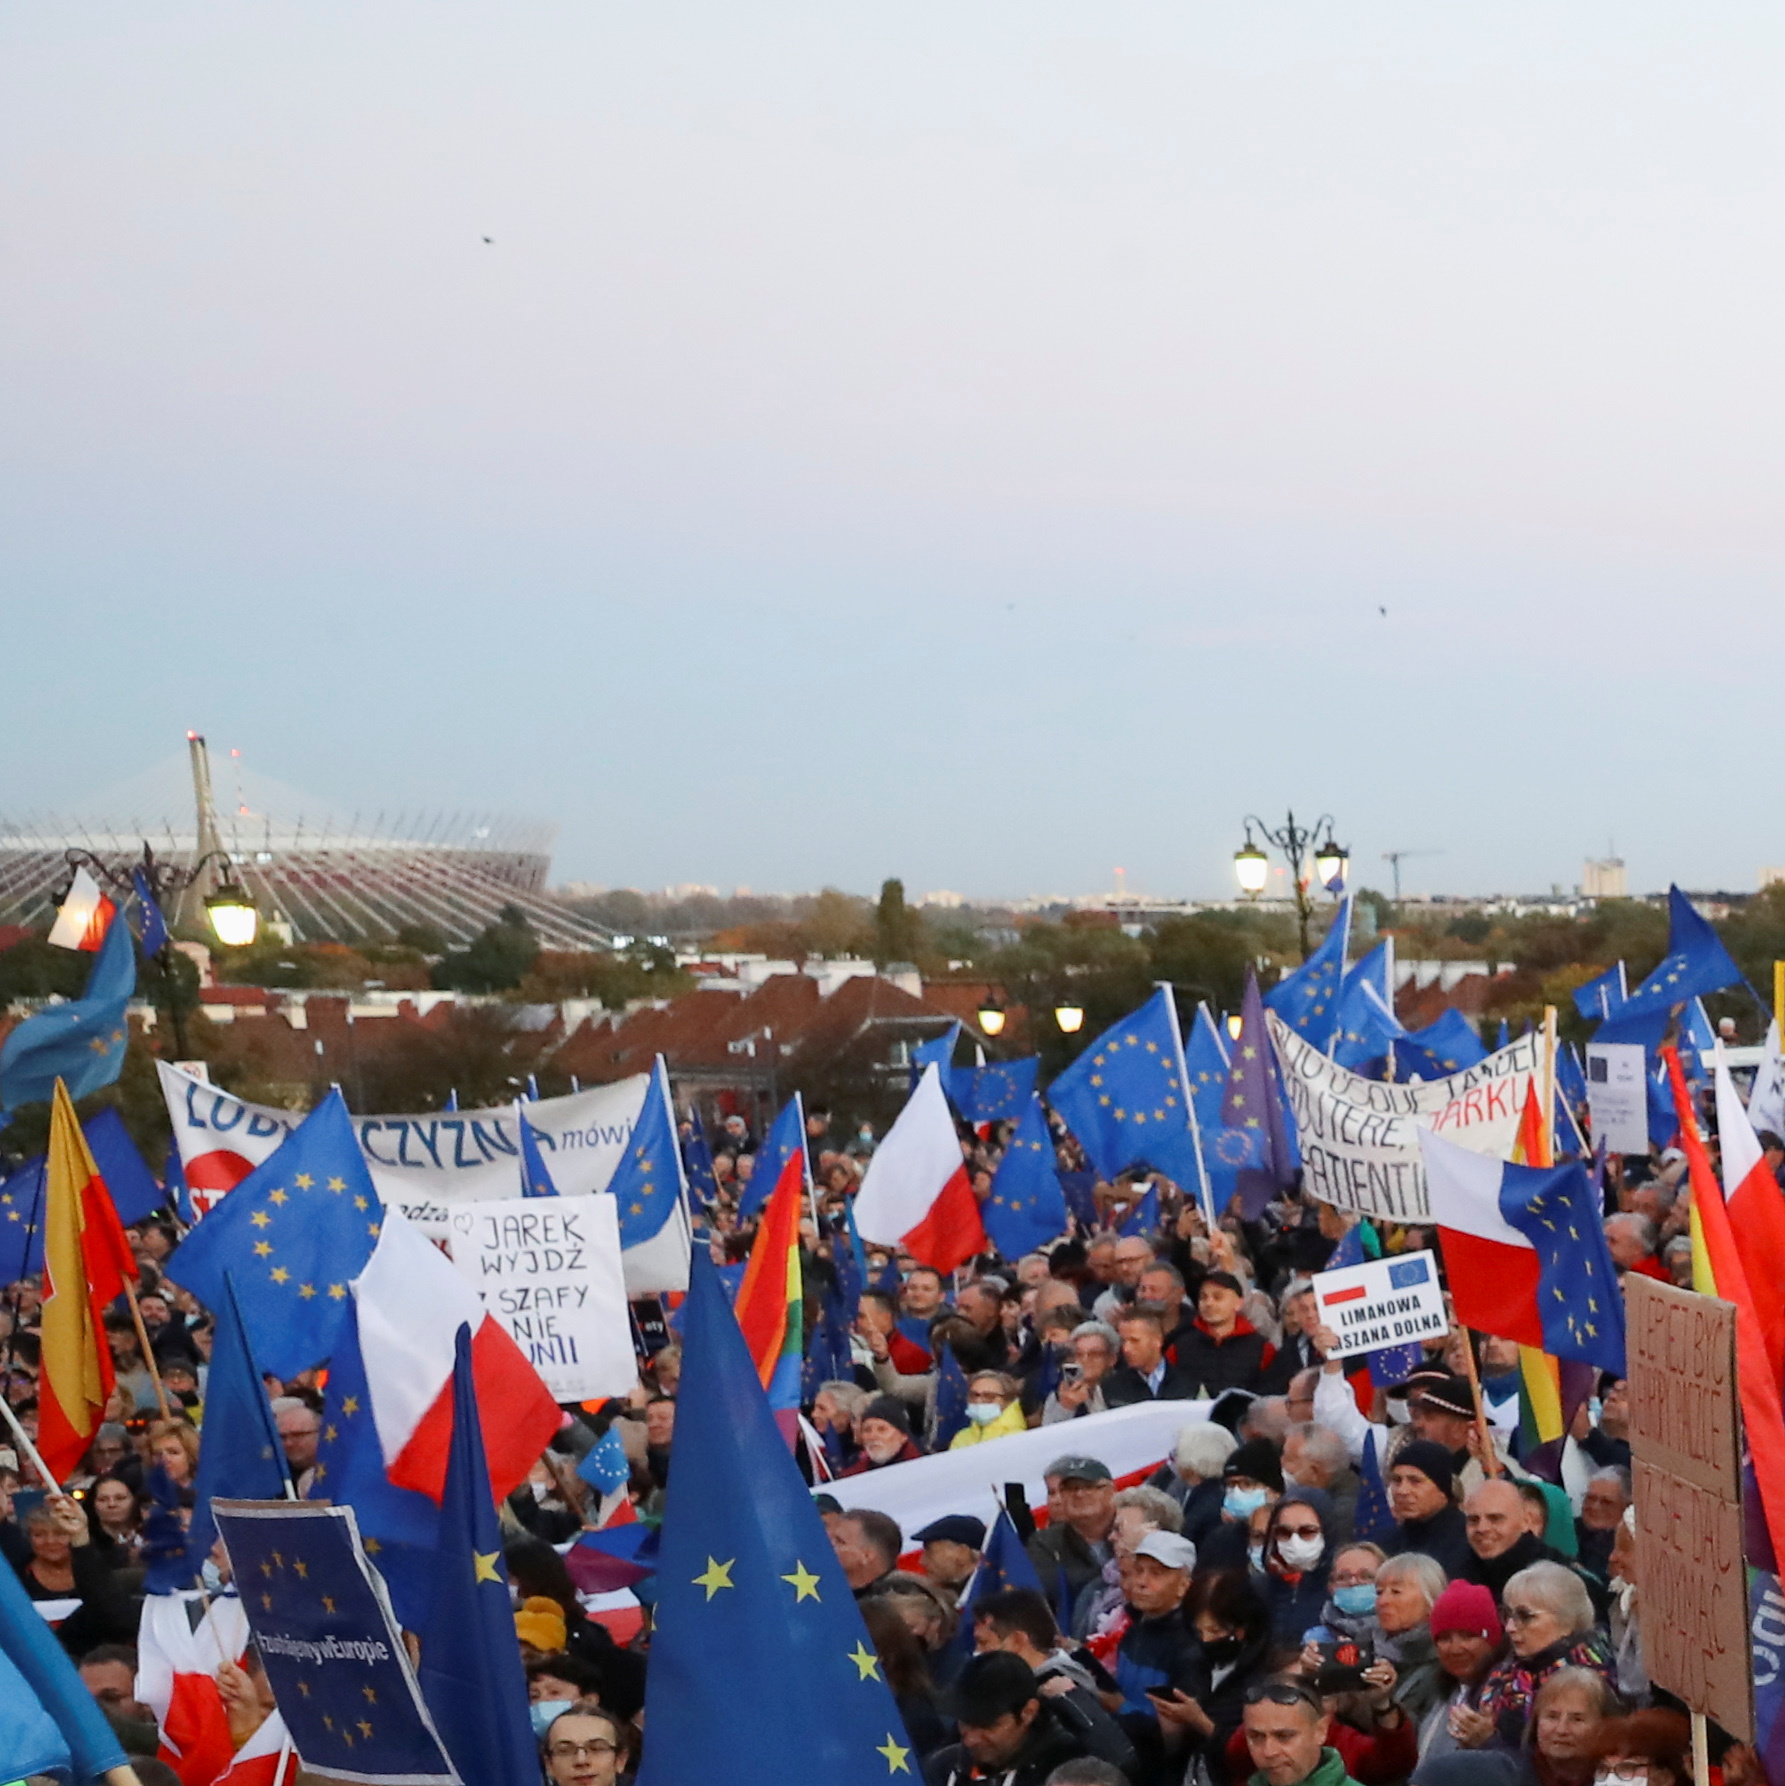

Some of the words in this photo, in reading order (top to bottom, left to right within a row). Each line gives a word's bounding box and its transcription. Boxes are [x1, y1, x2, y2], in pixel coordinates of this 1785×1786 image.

[483, 1214, 586, 1250] JAREK
[499, 1285, 589, 1315] SZAFY
[1340, 1295, 1422, 1327] LIMANOWA
[512, 1312, 558, 1340] NIE
[1393, 1313, 1442, 1338] DOLNA
